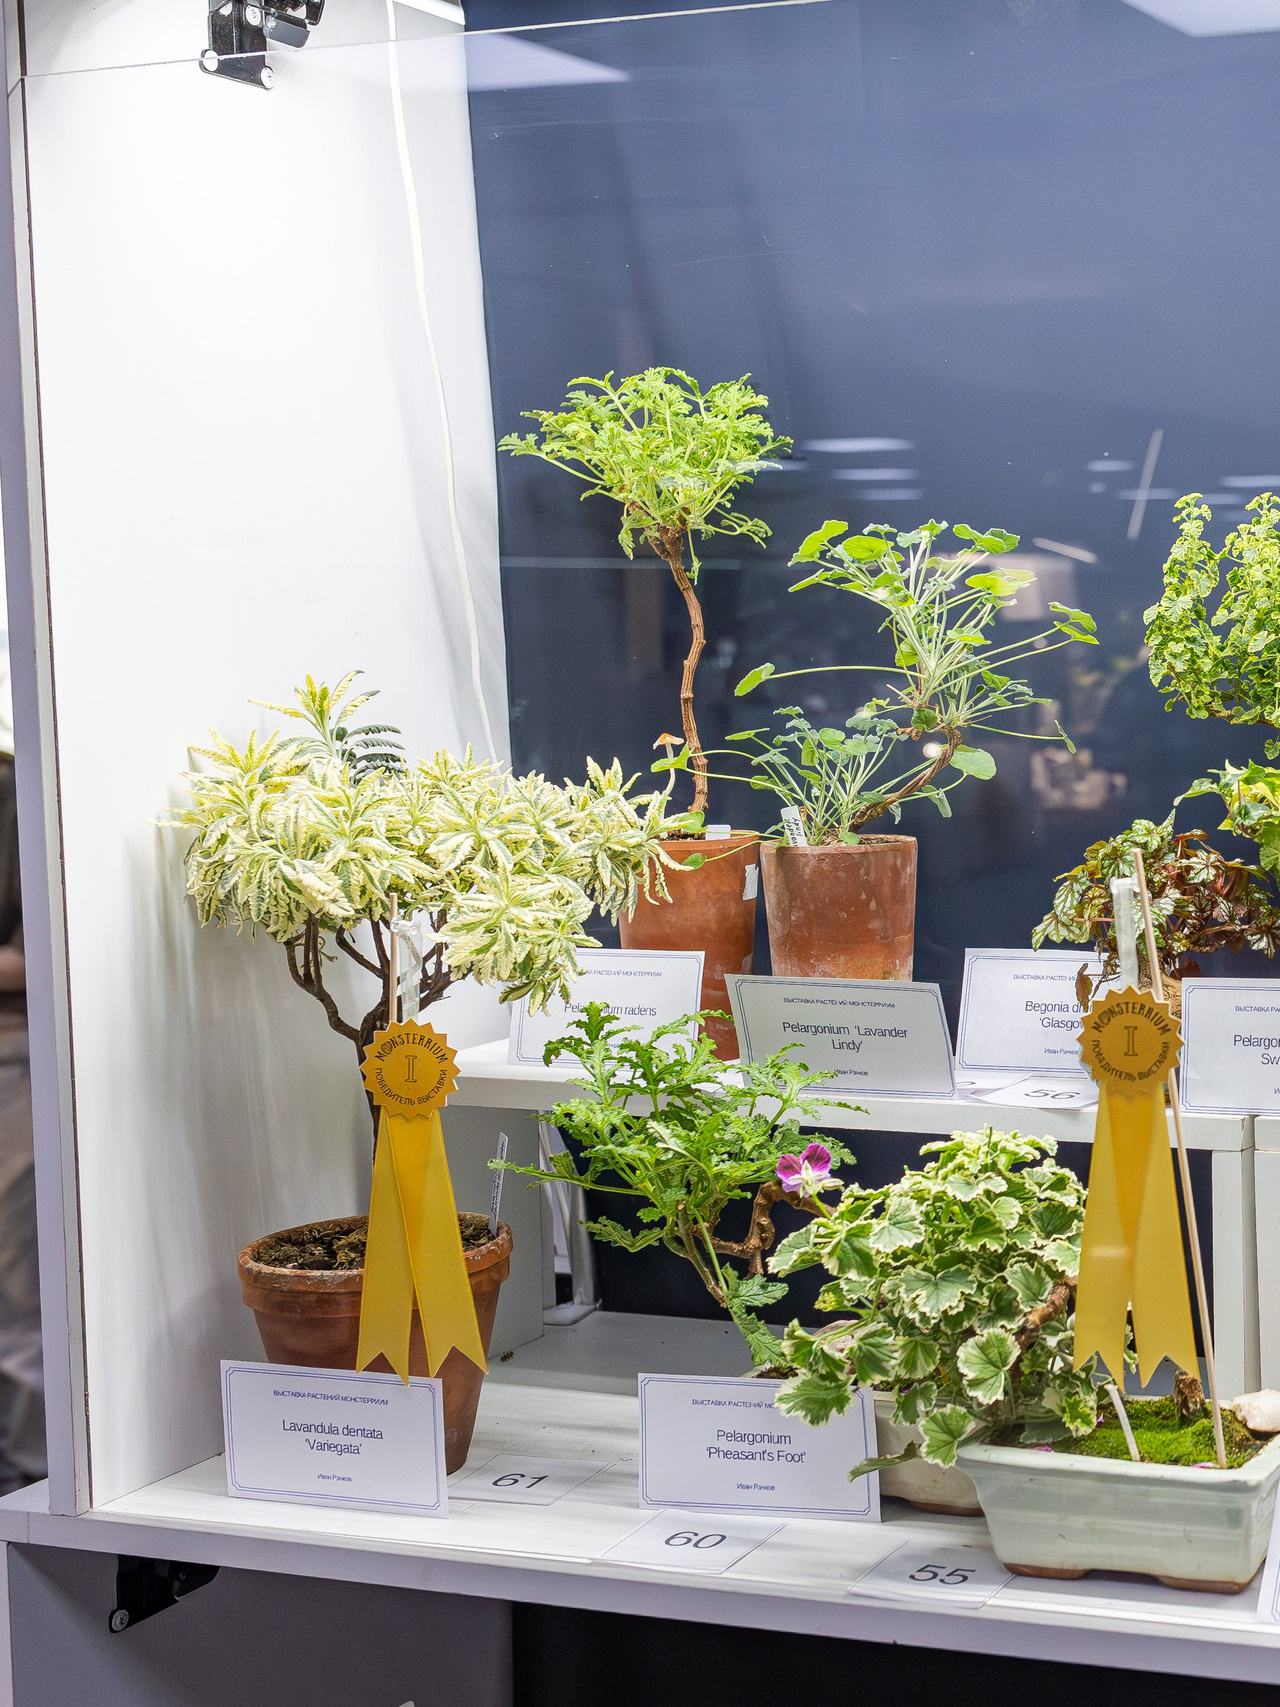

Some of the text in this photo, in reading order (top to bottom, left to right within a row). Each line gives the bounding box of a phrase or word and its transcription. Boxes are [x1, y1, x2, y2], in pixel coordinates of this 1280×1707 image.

[564, 1002, 657, 1016] Pelaium radens
[816, 998, 849, 1006] РАСТЕНИЙ
[1025, 1000, 1070, 1014] Begonia
[1091, 1001, 1172, 1036] MONSTERRIUM
[782, 1021, 908, 1038] Pelargonium ‘Lavander
[374, 1032, 449, 1064] MONSTERRIUM
[831, 1039, 863, 1053] Lindy’
[374, 1067, 448, 1106] ПОБЕДИТЕЛЬ ВЫСТАВКИ
[1024, 1089, 1081, 1100] 56
[273, 1389, 389, 1406] ВЫСТАВКА РАСТЕНИЙ МОНСТЕРРИУМ
[691, 1398, 728, 1407] ВЫСТАВКА
[728, 1400, 764, 1408] РАСТЕНИЙ
[282, 1419, 384, 1440] Lavandula dentata
[716, 1429, 792, 1446] Pelargonium
[492, 1473, 549, 1489] 61
[663, 1531, 727, 1549] 60
[908, 1563, 976, 1586] 55
